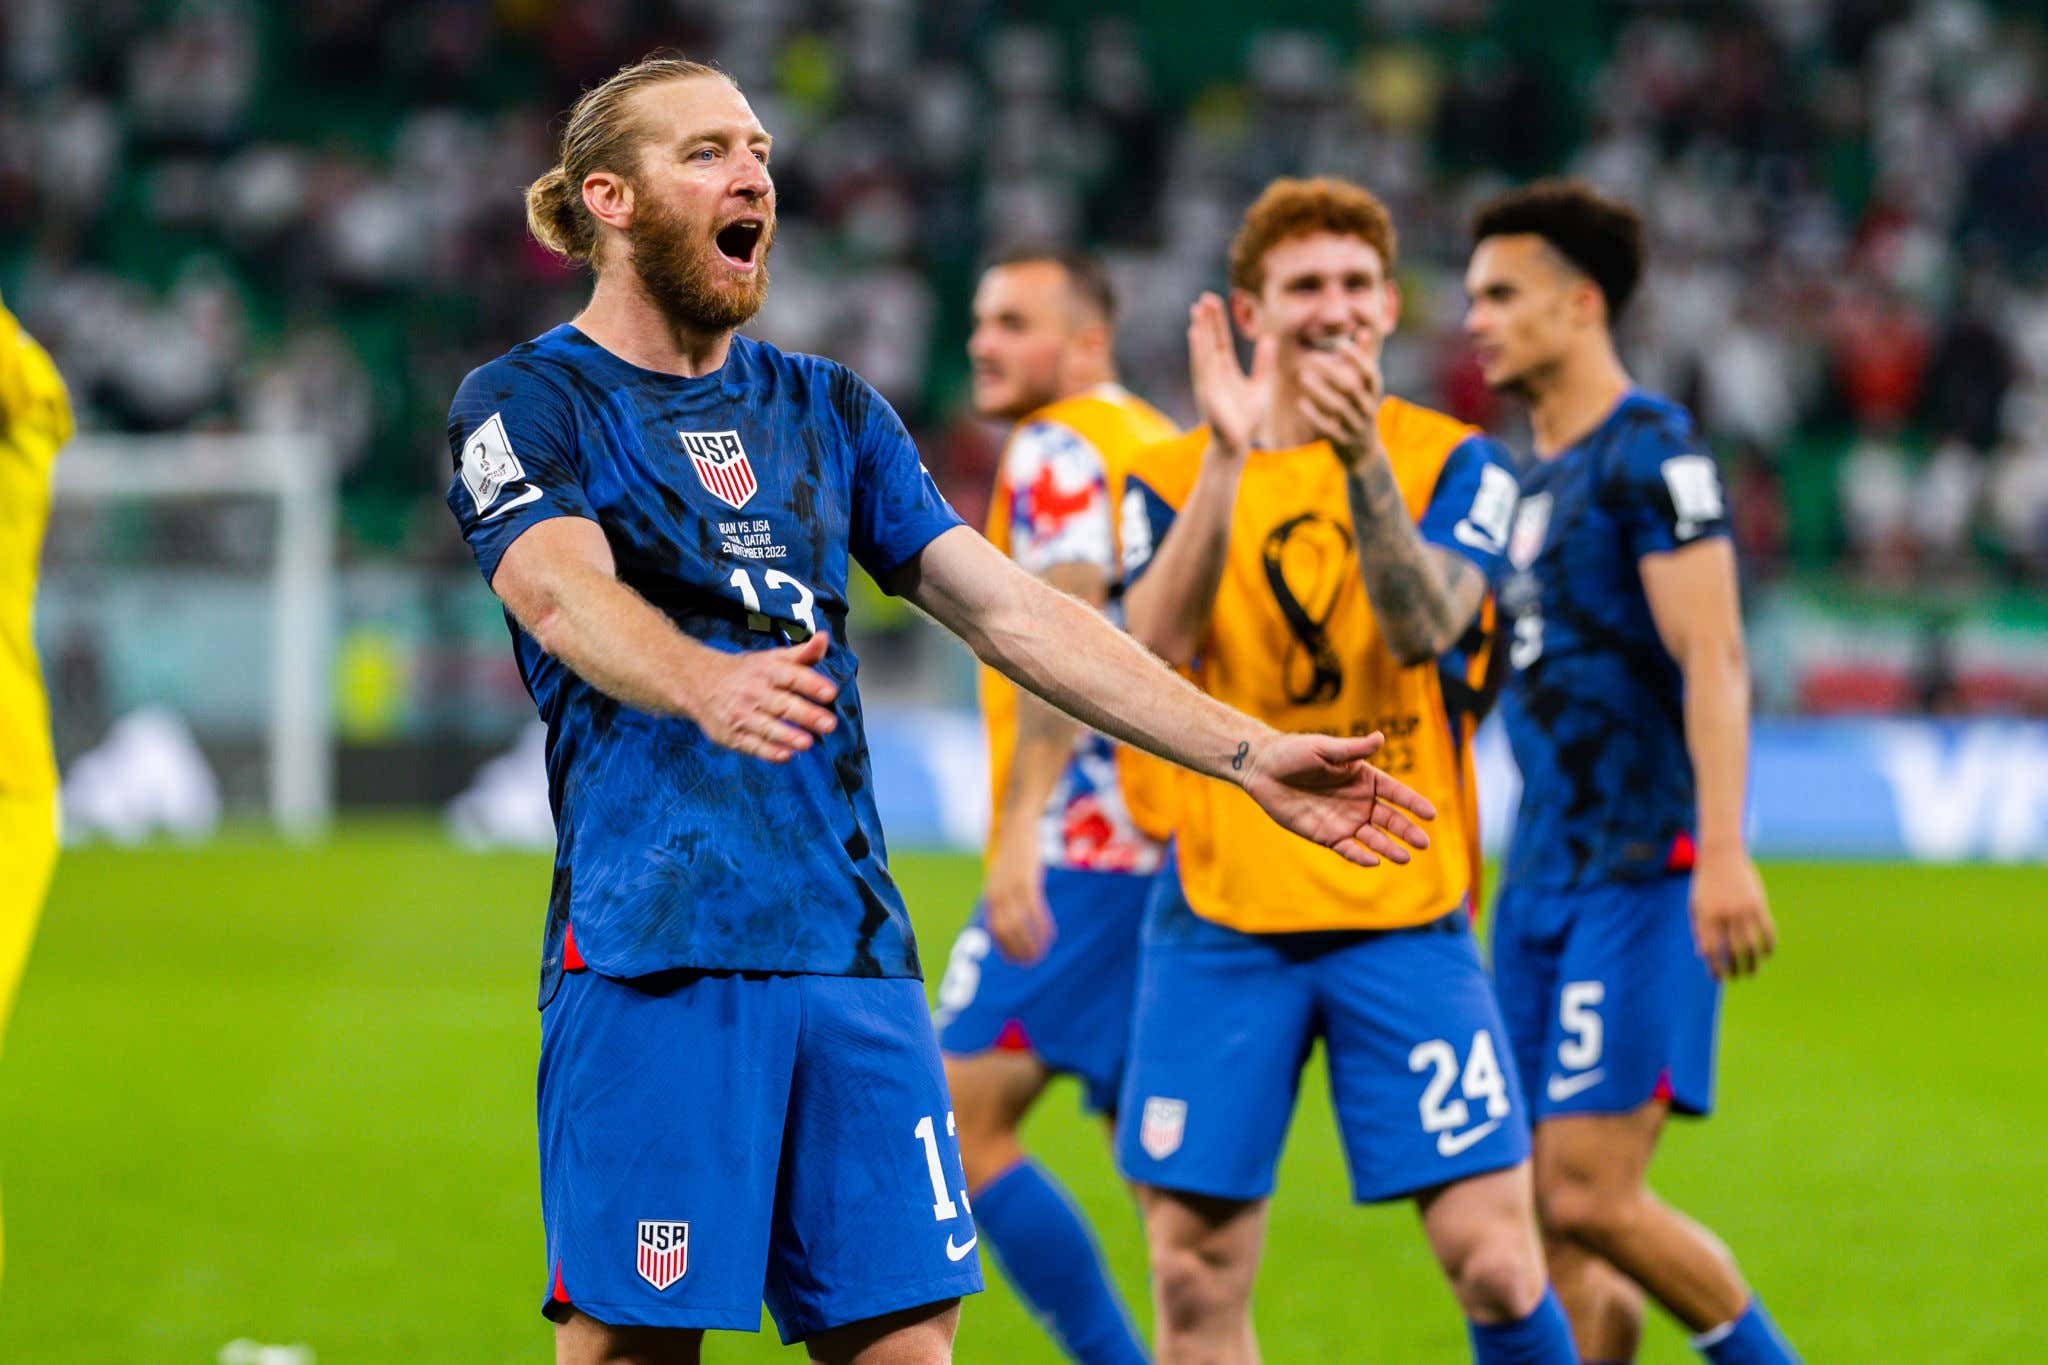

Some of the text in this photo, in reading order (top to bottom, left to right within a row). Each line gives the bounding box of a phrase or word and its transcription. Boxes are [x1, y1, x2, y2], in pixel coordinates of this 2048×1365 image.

[684, 435, 740, 465] USA
[738, 521, 752, 533] VS.
[753, 519, 771, 532] USA
[744, 533, 771, 546] QATAR
[765, 545, 786, 558] 2022
[729, 568, 816, 642] 13
[1557, 980, 1605, 1070] 5
[1408, 1028, 1511, 1133] 24
[641, 1224, 686, 1251] USA
